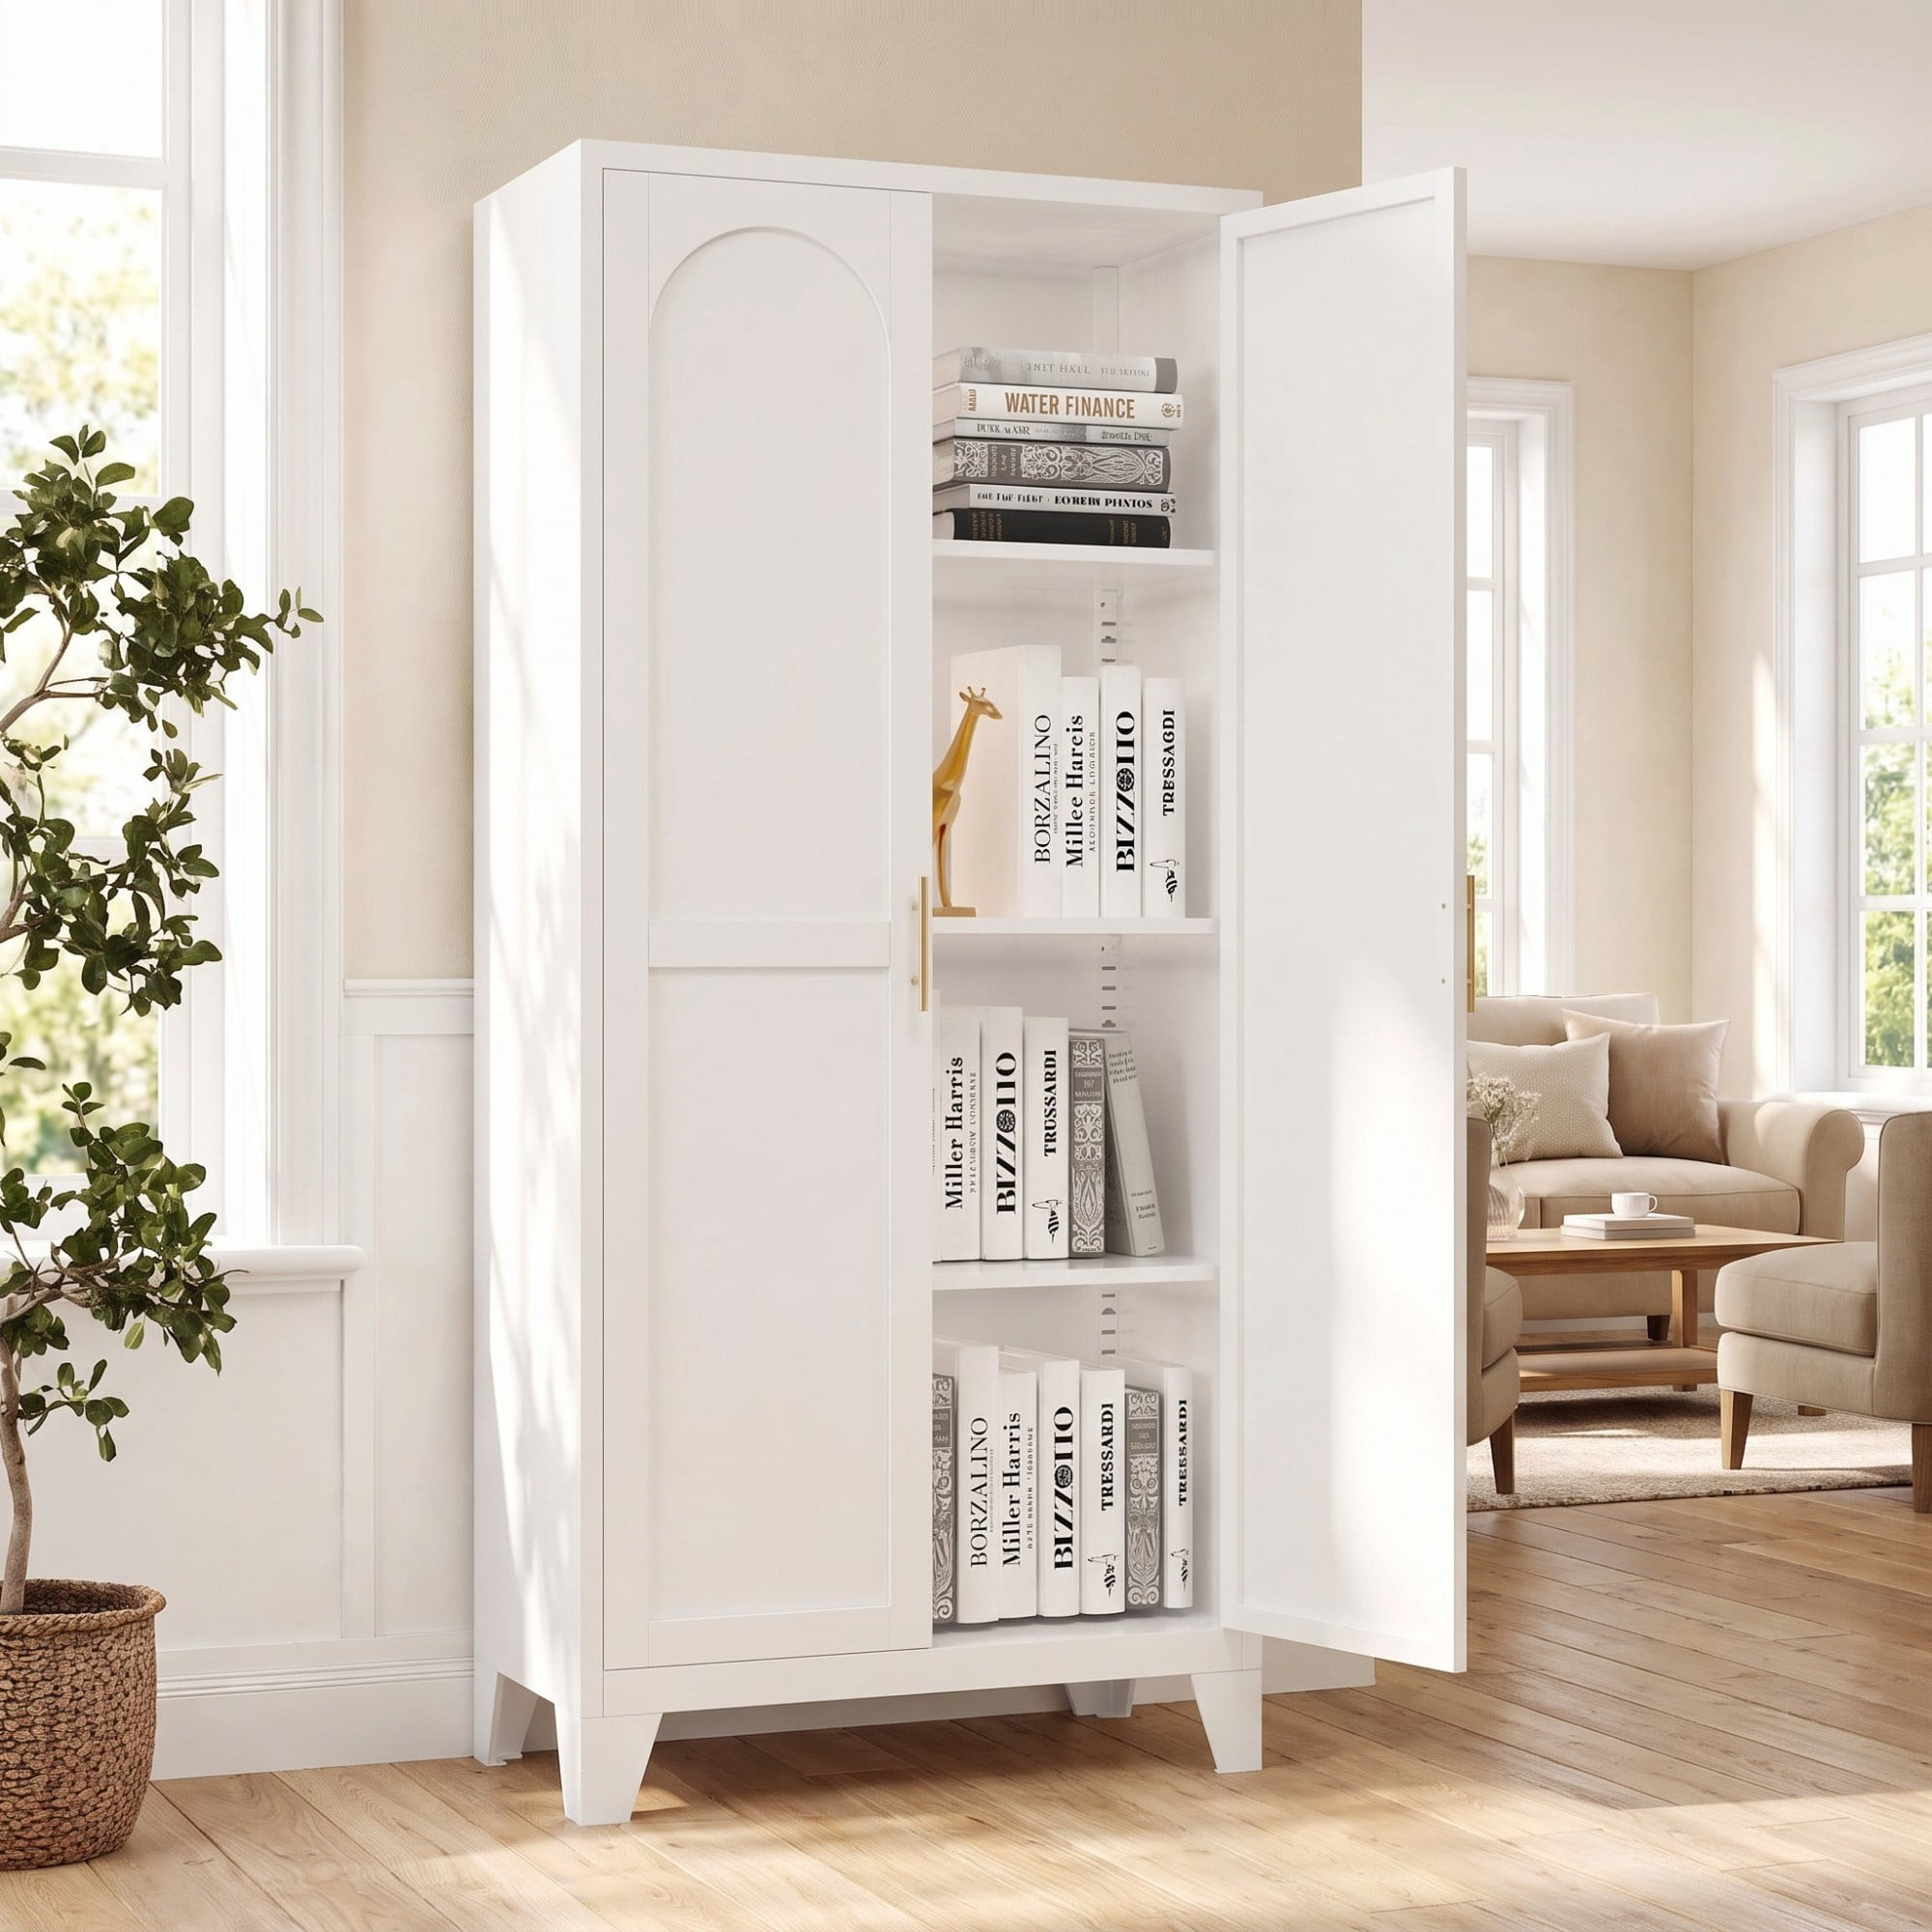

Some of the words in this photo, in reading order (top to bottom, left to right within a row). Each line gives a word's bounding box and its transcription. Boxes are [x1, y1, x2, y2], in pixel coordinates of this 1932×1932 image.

[1004, 391, 1060, 415] WATER
[1065, 395, 1136, 419] FINANCE
[1034, 714, 1052, 865] BORZALINO
[944, 1056, 964, 1132] Harris
[1043, 1049, 1058, 1158] TRUSSARDI
[944, 1138, 964, 1210] Miller
[1002, 1412, 1022, 1489] Harris
[1100, 1403, 1115, 1512] TRESSARDI
[970, 1417, 989, 1569] BORZALINO
[1002, 1493, 1022, 1568] Miller
